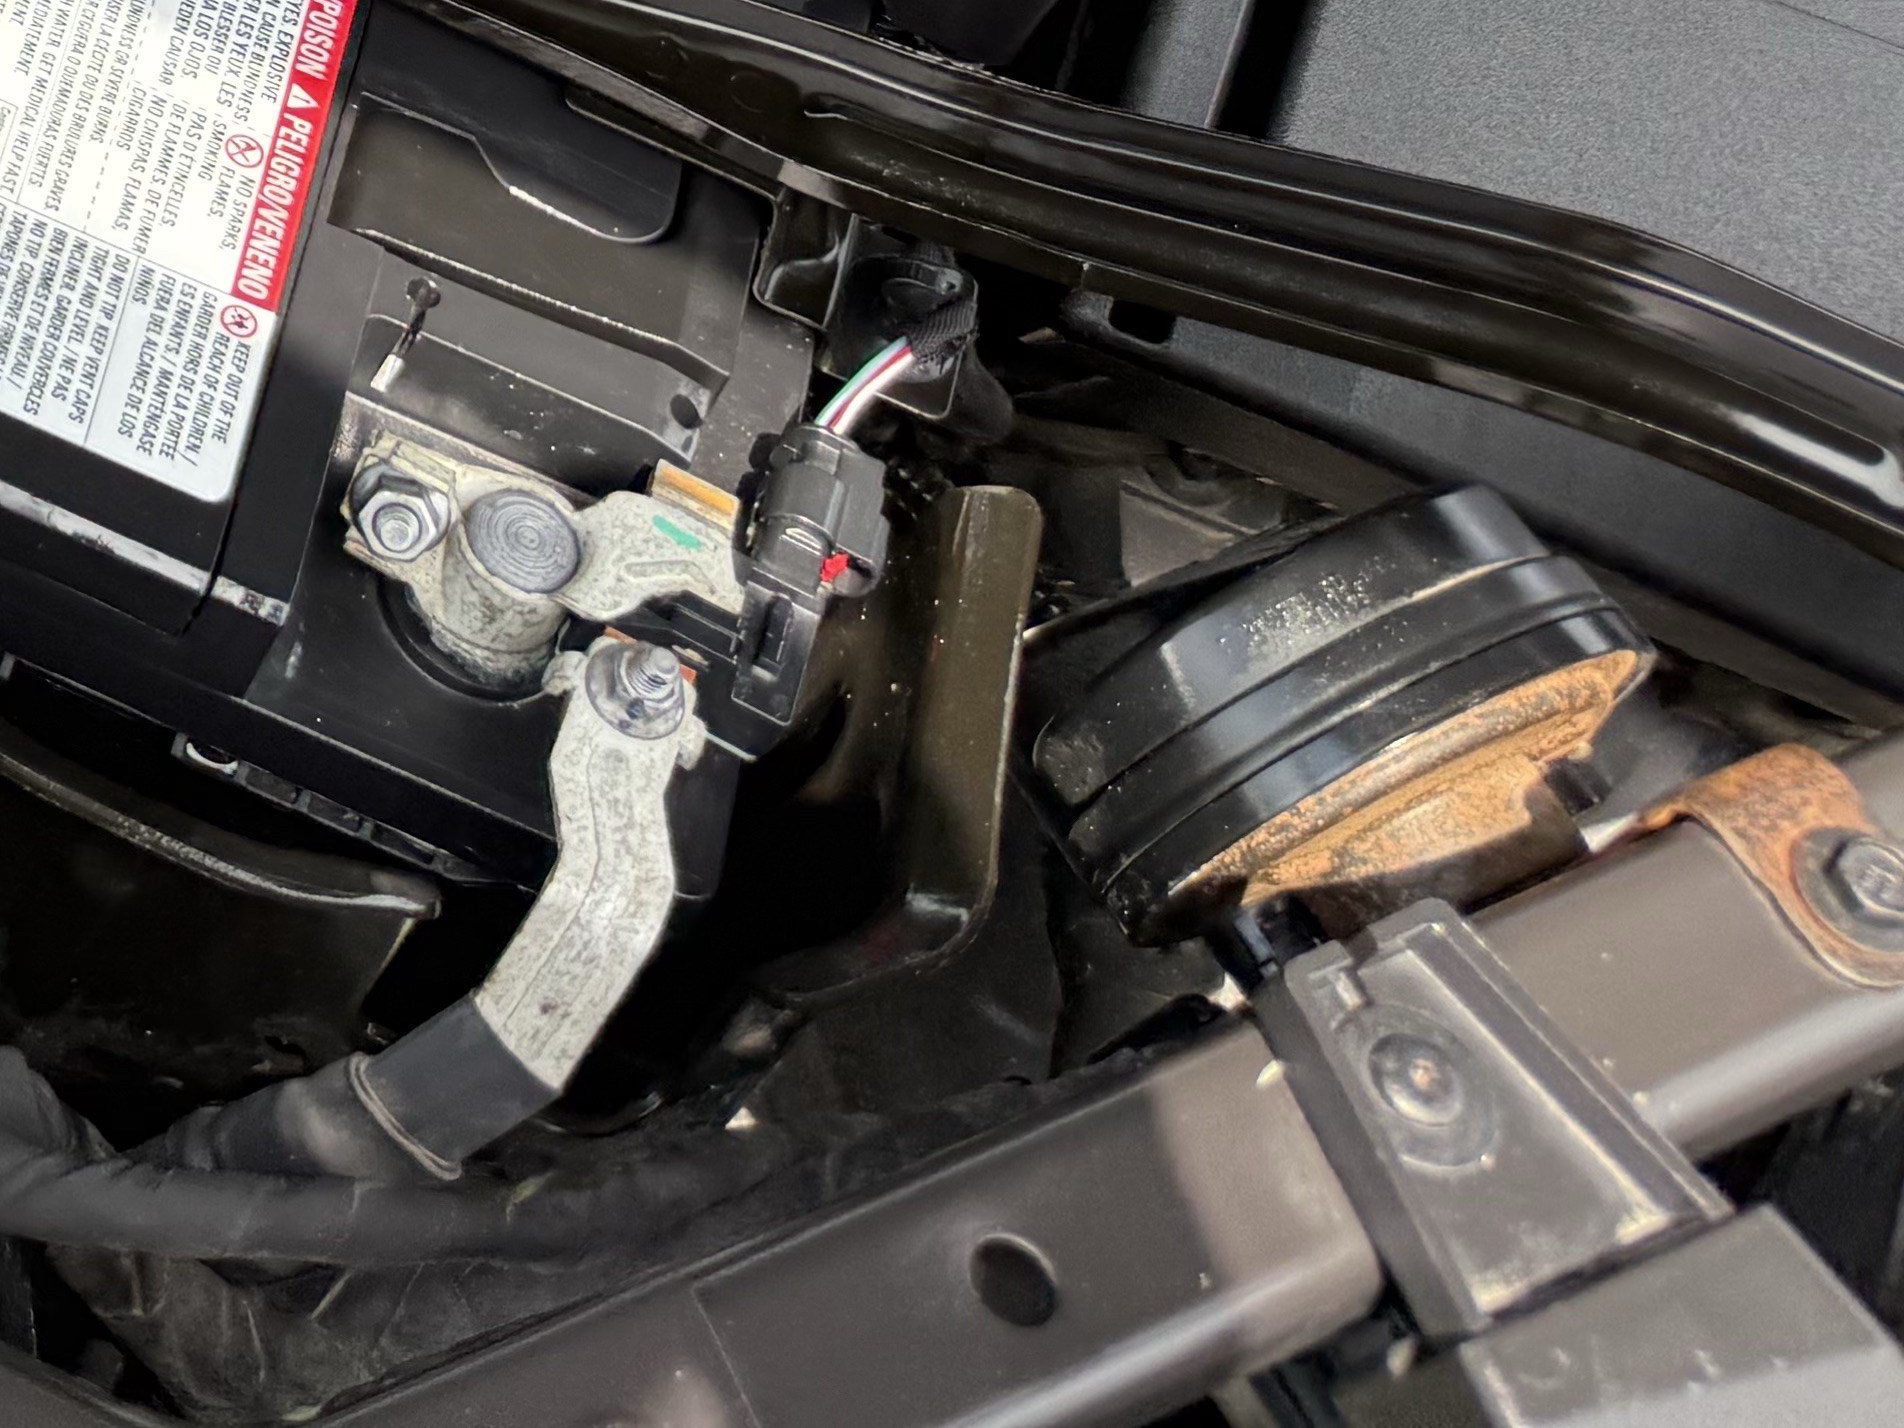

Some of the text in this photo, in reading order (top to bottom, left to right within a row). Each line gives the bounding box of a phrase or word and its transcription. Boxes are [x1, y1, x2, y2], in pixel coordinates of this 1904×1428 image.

[97, 21, 115, 38] LA
[191, 11, 213, 41] LOS
[210, 0, 237, 55] BLESSER
[253, 10, 277, 52] CAUSE
[37, 50, 57, 76] GET
[81, 72, 100, 92] OU
[157, 33, 185, 86] CAUSAR
[203, 53, 222, 75] OU
[215, 12, 257, 109] LES LES
[233, 50, 266, 123] BLINDNESS
[260, 28, 294, 104] EXPLOSIVE
[19, 74, 49, 128] MEDICAL
[42, 64, 79, 141] QUEMADURAS
[74, 89, 94, 113] DES
[115, 85, 146, 151] CIGARROS
[184, 110, 207, 141] PAS
[9, 129, 32, 162] HELP
[111, 93, 167, 231] NO CHISPAS, FLAMAS,
[197, 119, 227, 181] SMOKING
[130, 102, 187, 255] DE DE FUMER
[236, 109, 313, 300] PELIGRO/VENENO
[28, 217, 47, 238] NO
[218, 173, 256, 251] NO SPARKS,
[46, 226, 68, 256] BIEN
[3, 260, 34, 322] CONSERVE
[28, 299, 46, 317] ET
[130, 263, 156, 306] NIÑOS.
[22, 314, 42, 333] DE
[50, 244, 109, 402] TIGHT AND NE PAS
[67, 253, 129, 424] DO NOT KEEP VENT CAPS
[171, 290, 217, 411] GARDER HORS DE LA
[22, 293, 71, 417] GARDER COUVERCLES
[117, 272, 176, 439] FUERA DEL ALCANCE DE LOS
[205, 330, 230, 374] REACH
[201, 372, 219, 391] OF
[210, 339, 251, 444] KEEP OUT OF THE
[136, 366, 175, 457] MANTÉNGASE
